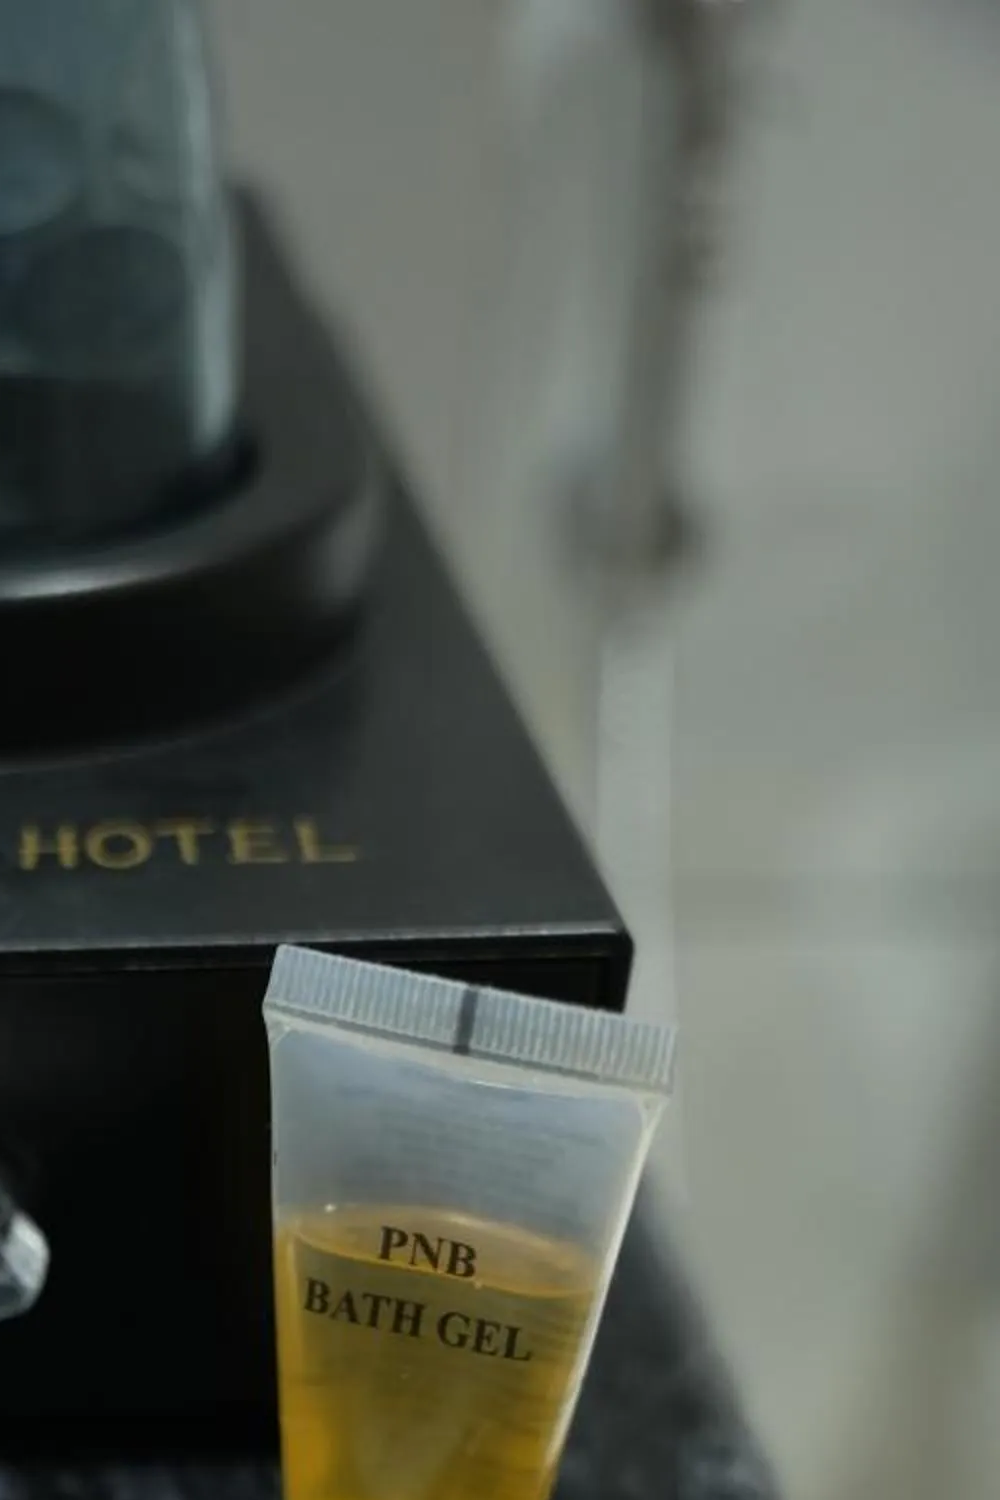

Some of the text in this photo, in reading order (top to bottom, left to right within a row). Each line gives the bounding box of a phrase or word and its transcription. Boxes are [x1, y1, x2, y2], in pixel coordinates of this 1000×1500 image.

[16, 817, 359, 871] HOTEL
[378, 1225, 477, 1278] PNB
[303, 1276, 534, 1362] BATH GEL
